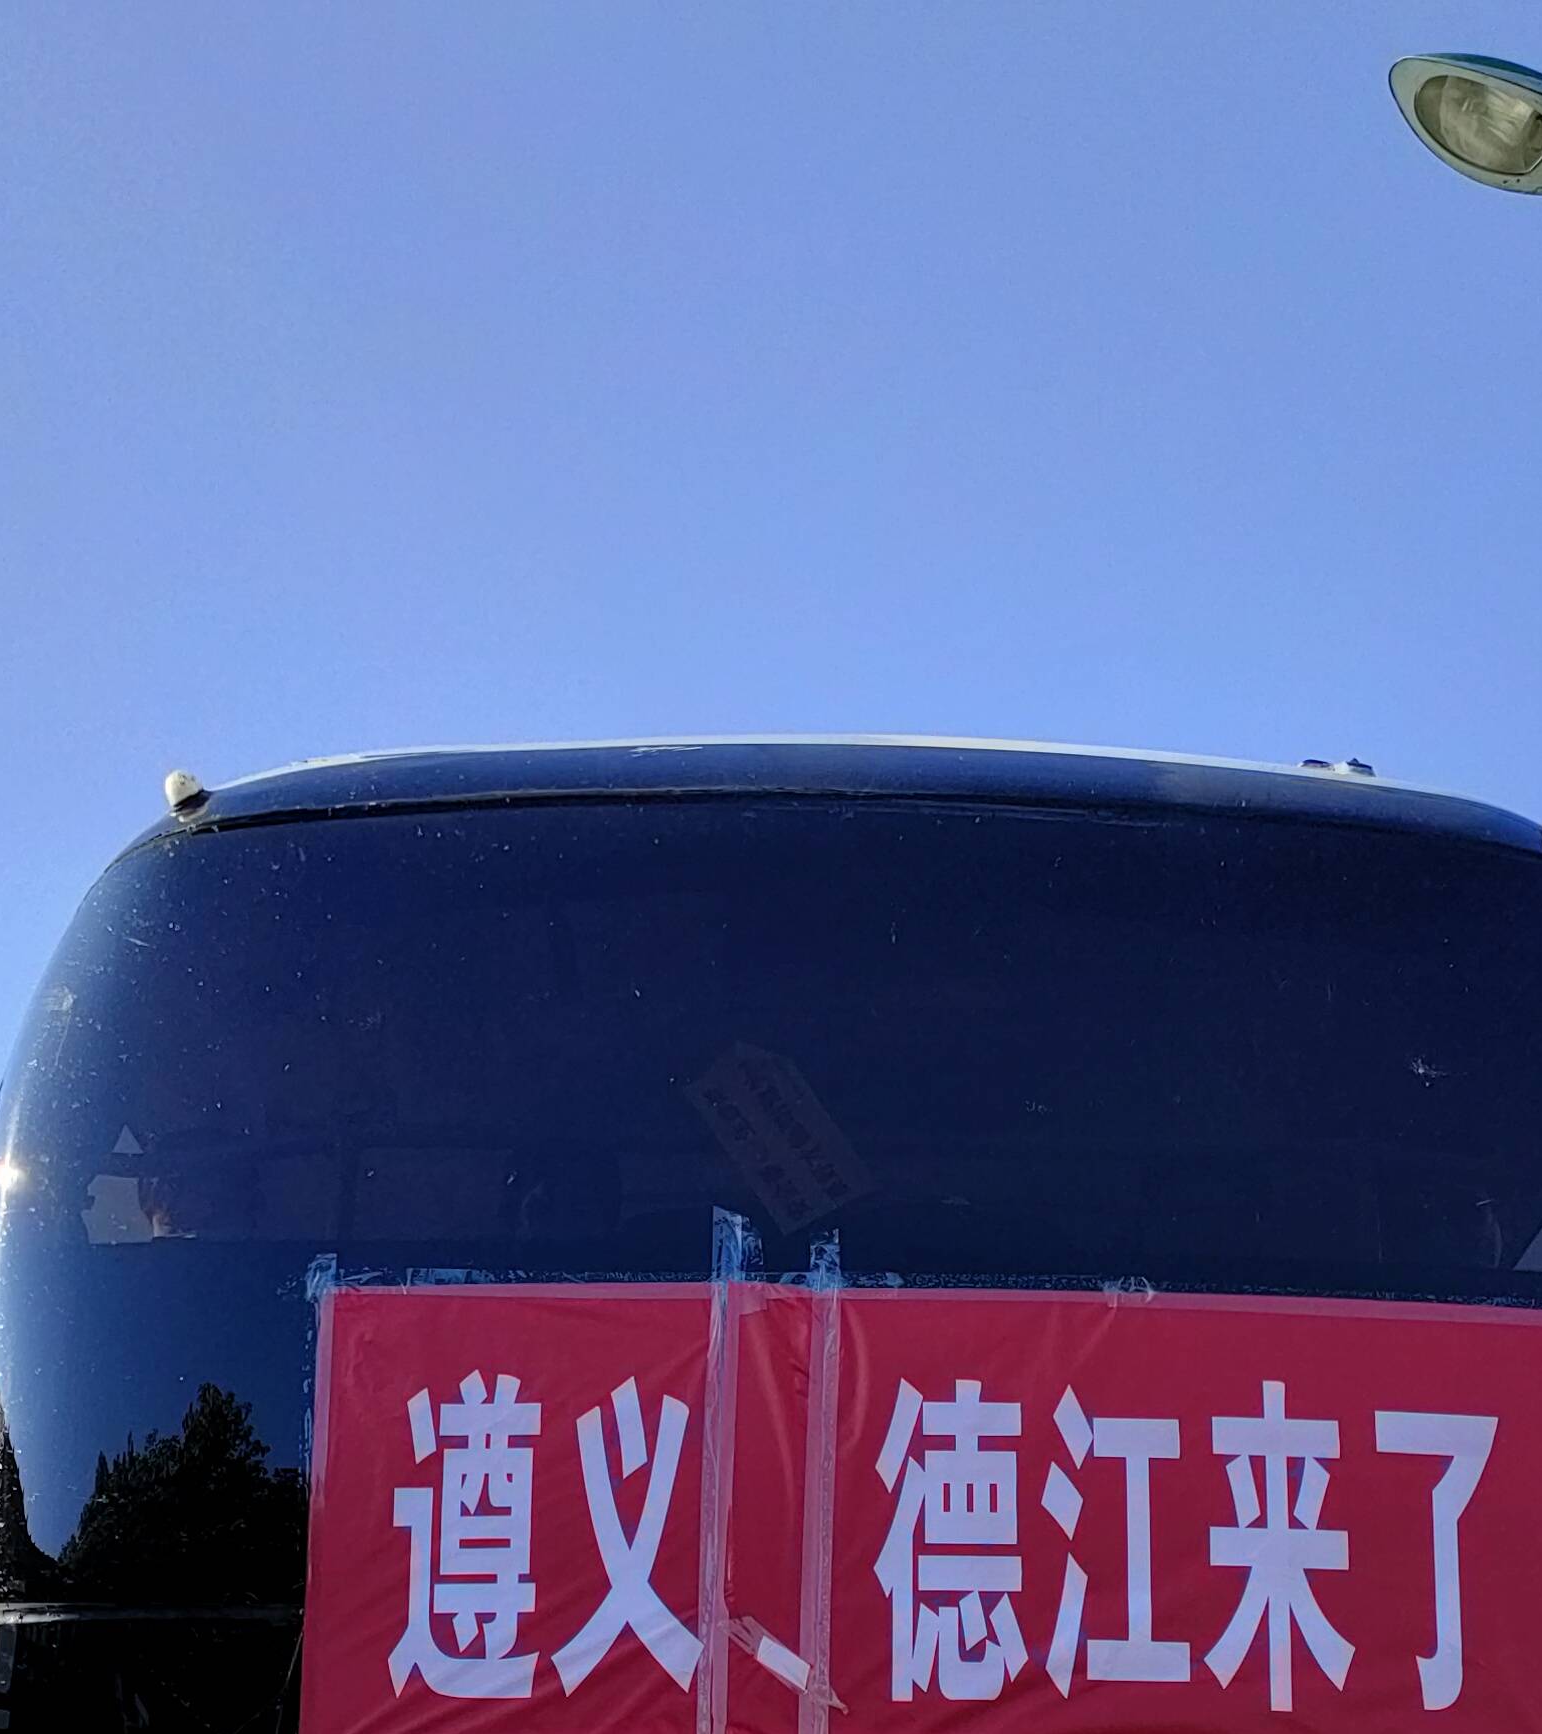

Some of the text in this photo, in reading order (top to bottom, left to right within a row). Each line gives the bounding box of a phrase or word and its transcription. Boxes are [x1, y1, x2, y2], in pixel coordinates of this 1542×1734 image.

[388, 1369, 1499, 1713] 遵义、德江来了
